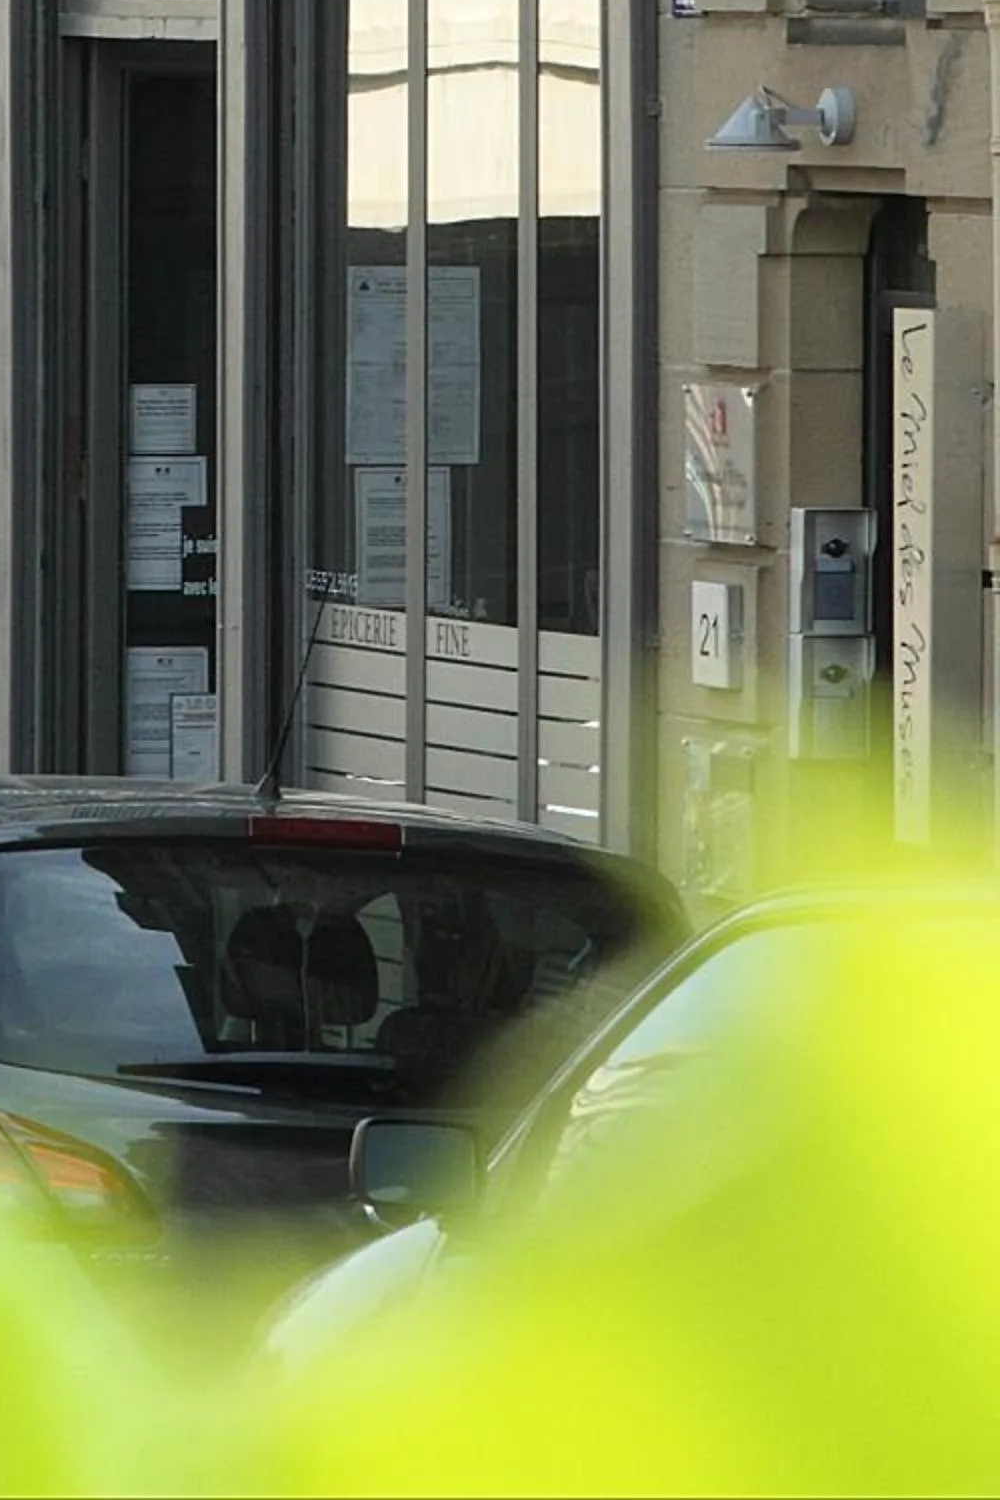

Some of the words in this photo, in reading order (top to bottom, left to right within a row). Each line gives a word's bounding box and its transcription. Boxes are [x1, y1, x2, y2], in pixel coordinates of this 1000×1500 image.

[901, 323, 927, 380] Le
[330, 607, 397, 647] EPICERIE
[436, 623, 471, 657] FINE
[699, 612, 720, 659] 21
